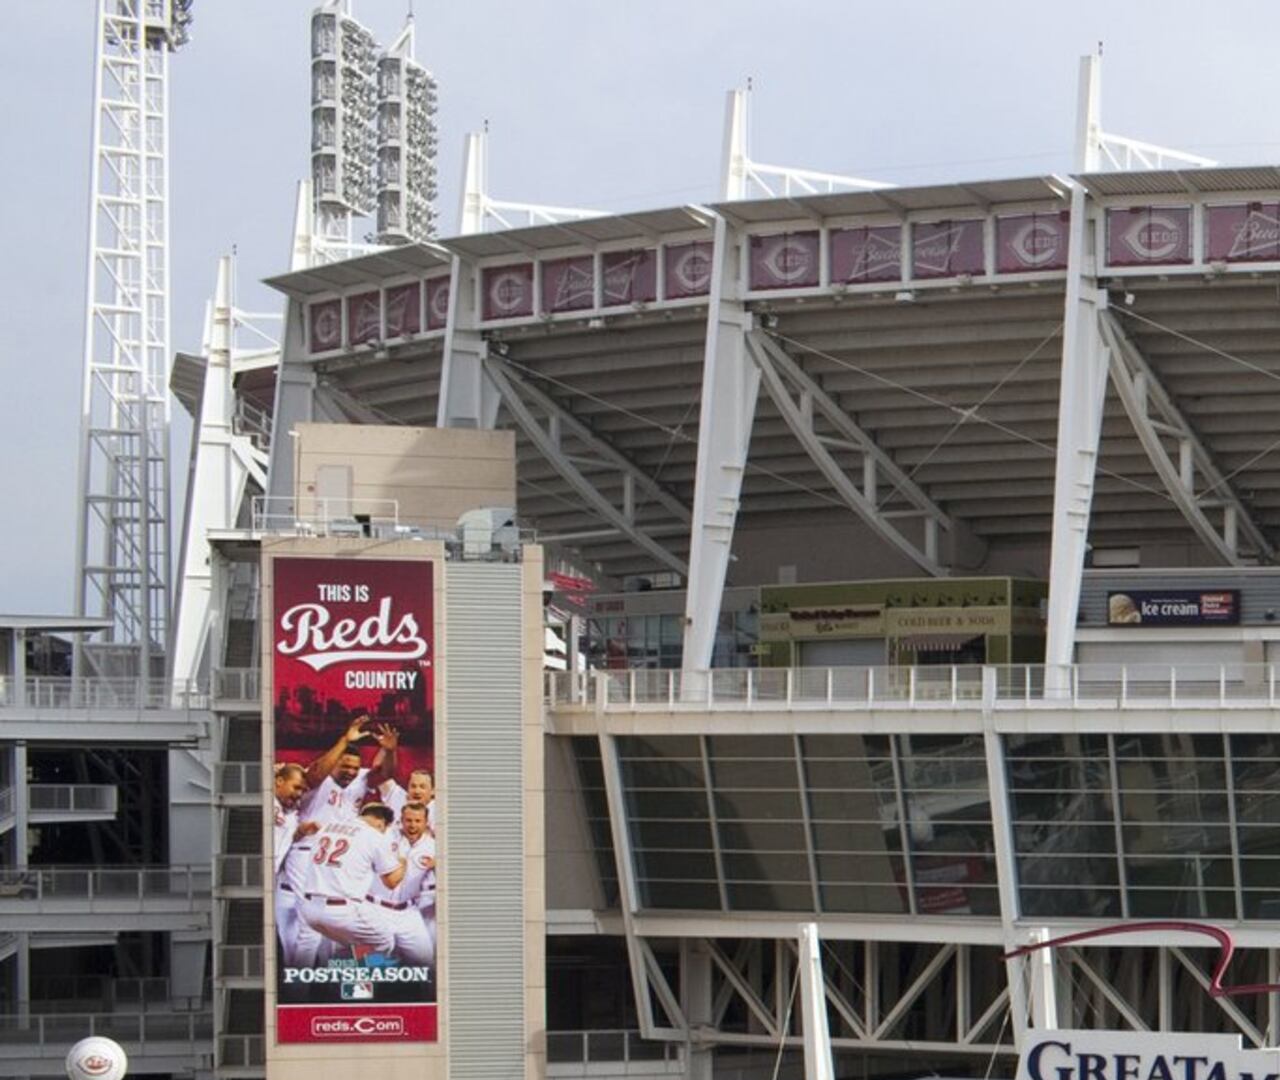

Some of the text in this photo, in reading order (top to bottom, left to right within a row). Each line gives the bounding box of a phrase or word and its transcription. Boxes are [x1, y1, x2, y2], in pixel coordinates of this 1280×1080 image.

[1140, 231, 1179, 244] REDS
[317, 584, 370, 602] THIS IS
[1141, 601, 1159, 616] Ice
[1161, 603, 1199, 616] cream
[276, 596, 428, 664] Reds
[345, 671, 418, 689] COUNTRY
[313, 837, 349, 868] 32
[283, 967, 429, 983] POSTSEASON
